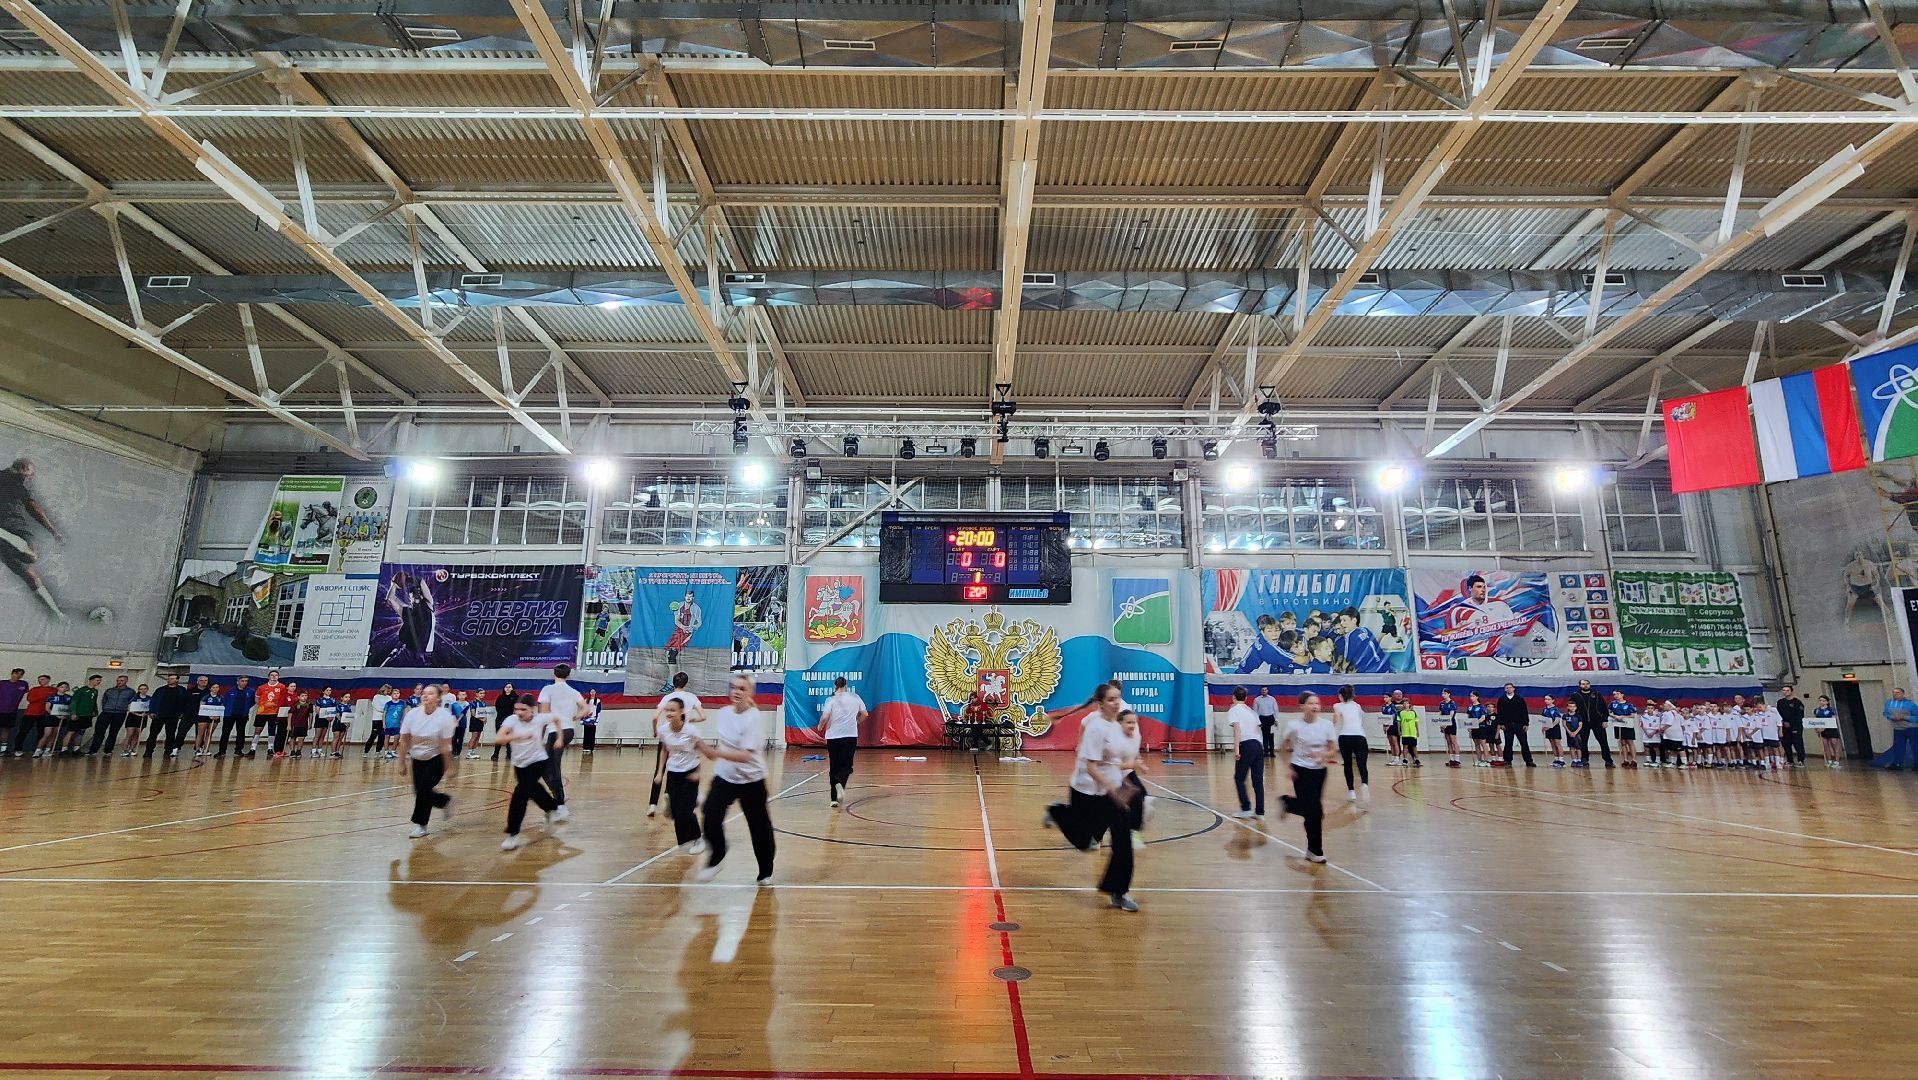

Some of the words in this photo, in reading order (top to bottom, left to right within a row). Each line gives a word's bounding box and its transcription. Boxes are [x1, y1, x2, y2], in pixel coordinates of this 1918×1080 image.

[955, 530, 995, 546] 20:00
[450, 572, 540, 580] ТУРБОКОМПЛЕКТ
[314, 584, 347, 592] ФАВОРИТ
[1258, 573, 1351, 597] ГАНДБОЛ
[1273, 598, 1351, 606] ПРОТВИНО
[467, 600, 568, 618] ЭНЕРГИЯ
[1698, 608, 1734, 617] Серпухов
[1482, 615, 1488, 624] 8
[461, 617, 562, 636] СПОРТА
[585, 651, 628, 666] СПОНС
[801, 671, 863, 681] АДМИНИСТРАЦИЯ
[1113, 672, 1175, 682] АДМИНИСТРАЦИЯ
[1131, 687, 1159, 698] ГОРОДА
[1131, 703, 1164, 713] РОТВИНО
